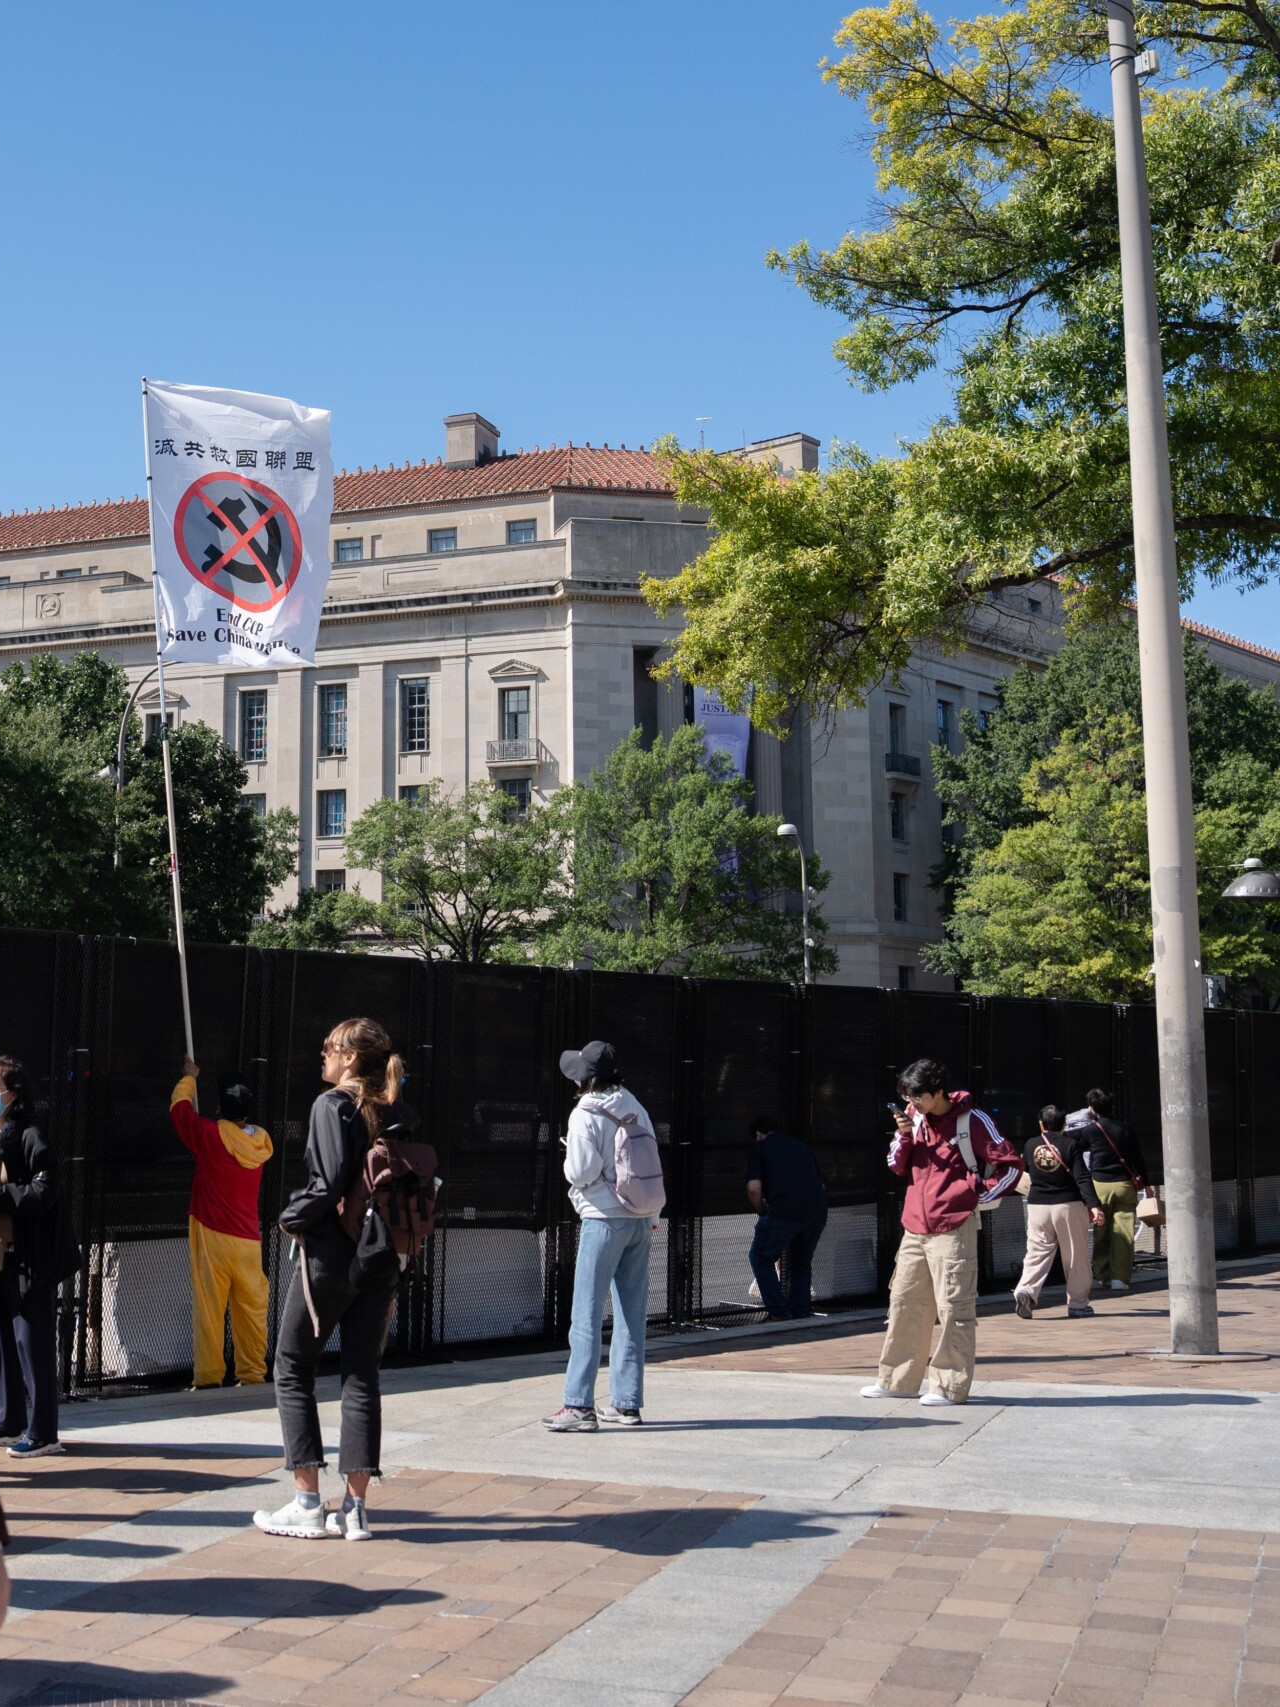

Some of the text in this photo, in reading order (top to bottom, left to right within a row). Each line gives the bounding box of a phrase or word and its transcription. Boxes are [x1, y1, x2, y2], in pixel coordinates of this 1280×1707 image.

[154, 438, 316, 472] 滅共救國聯盟
[217, 608, 263, 636] End CCP
[166, 628, 207, 642] Save
[214, 627, 252, 648] China
[701, 704, 741, 713] JUST
